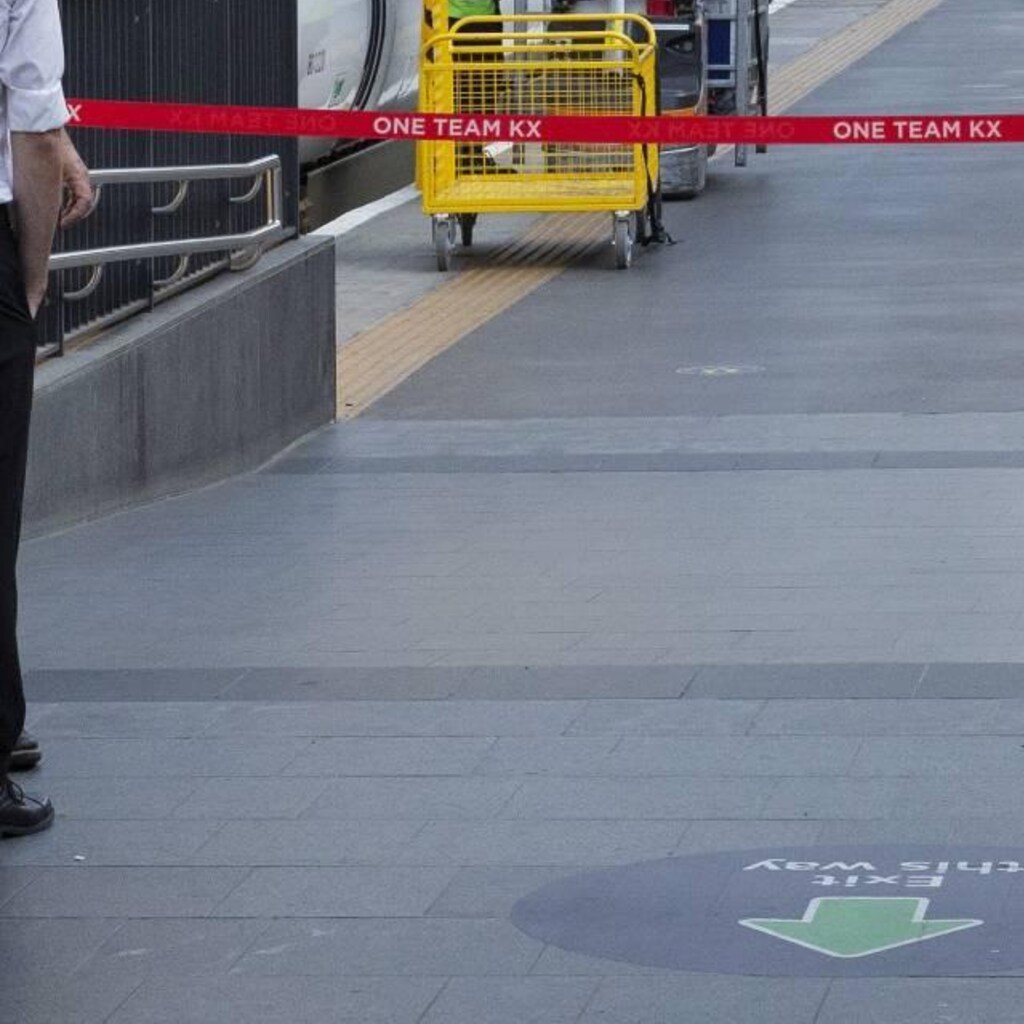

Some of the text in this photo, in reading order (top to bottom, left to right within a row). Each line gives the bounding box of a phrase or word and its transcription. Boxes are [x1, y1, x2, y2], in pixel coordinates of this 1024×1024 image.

[373, 117, 542, 139] ONE TEAM KX
[833, 119, 1002, 140] ONE TEAM KX
[742, 858, 876, 871] way
[811, 875, 944, 887] Exit
